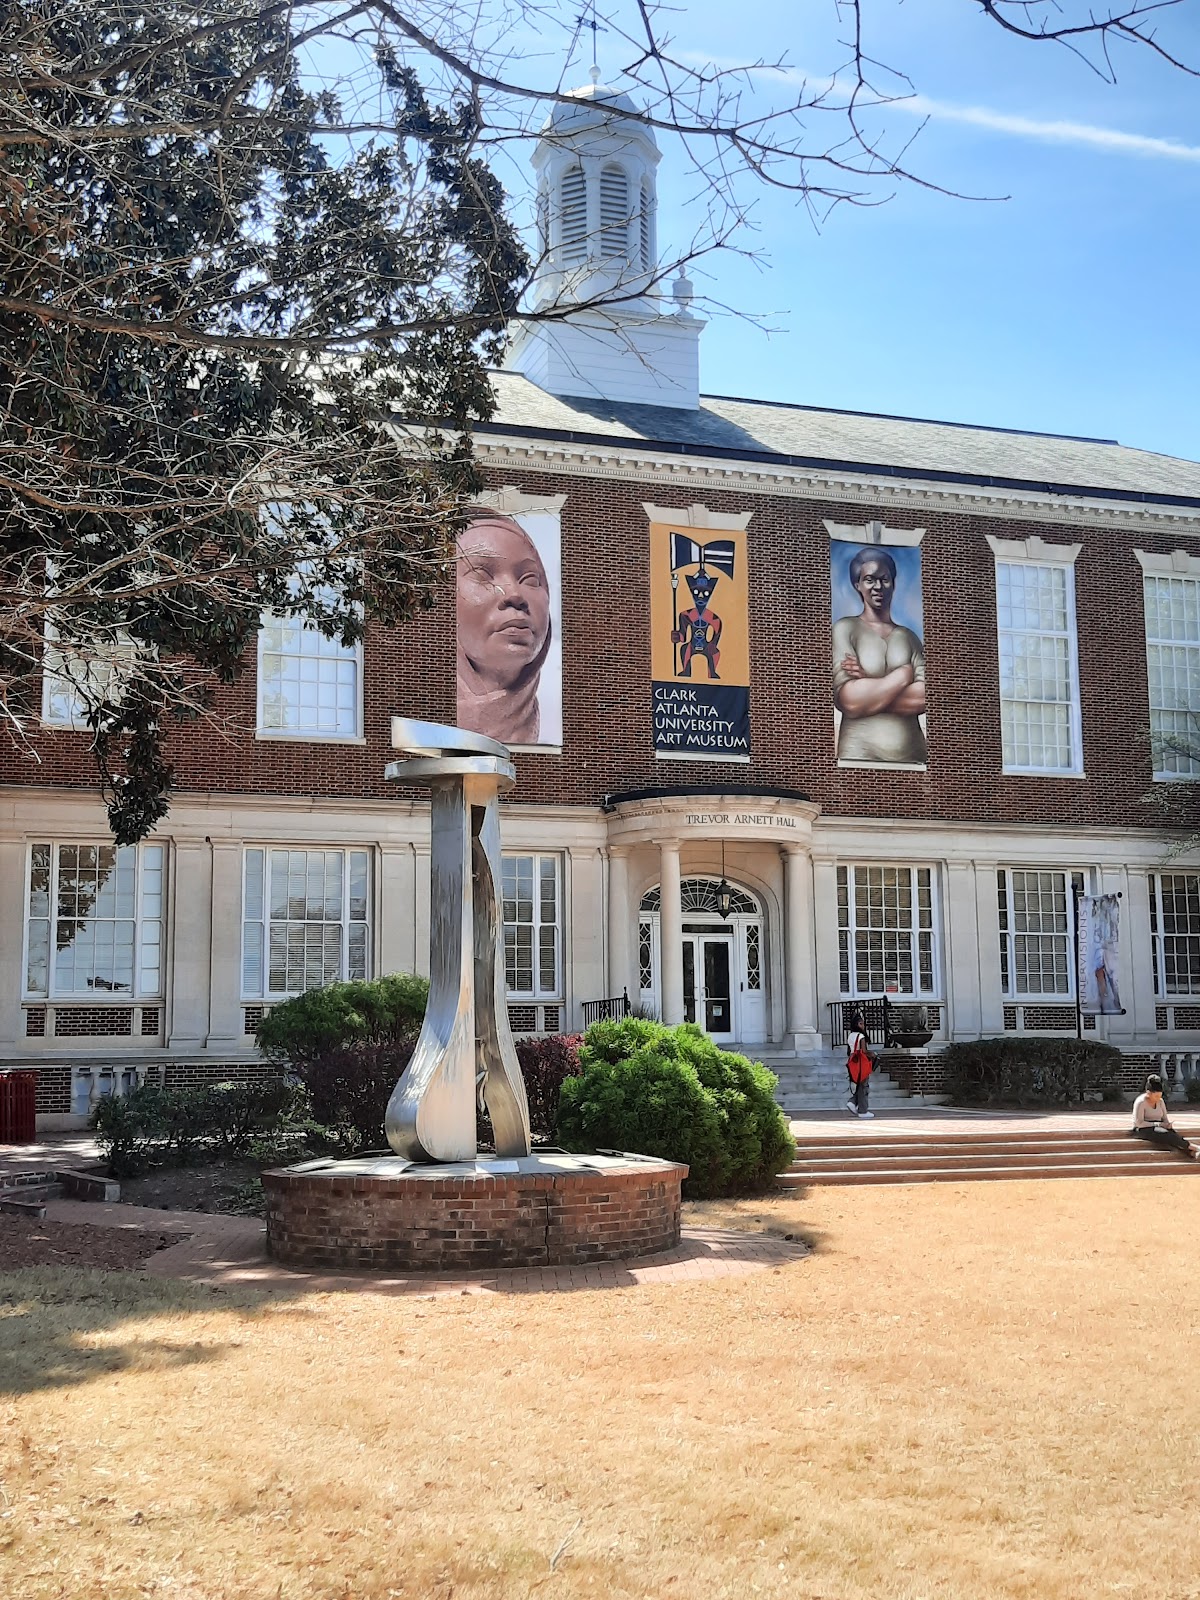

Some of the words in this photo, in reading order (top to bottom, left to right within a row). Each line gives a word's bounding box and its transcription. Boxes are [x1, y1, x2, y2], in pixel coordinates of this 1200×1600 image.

[654, 687, 697, 702] CLARK
[655, 702, 719, 718] ATLANTA
[655, 717, 735, 733] UNIVERSITY
[656, 732, 683, 745] ART
[686, 734, 748, 749] MUSEUM
[685, 814, 730, 825] TREVOR
[734, 814, 774, 826] ARNETT
[776, 816, 797, 828] HALL
[1079, 910, 1089, 1009] INNERVISIONS
